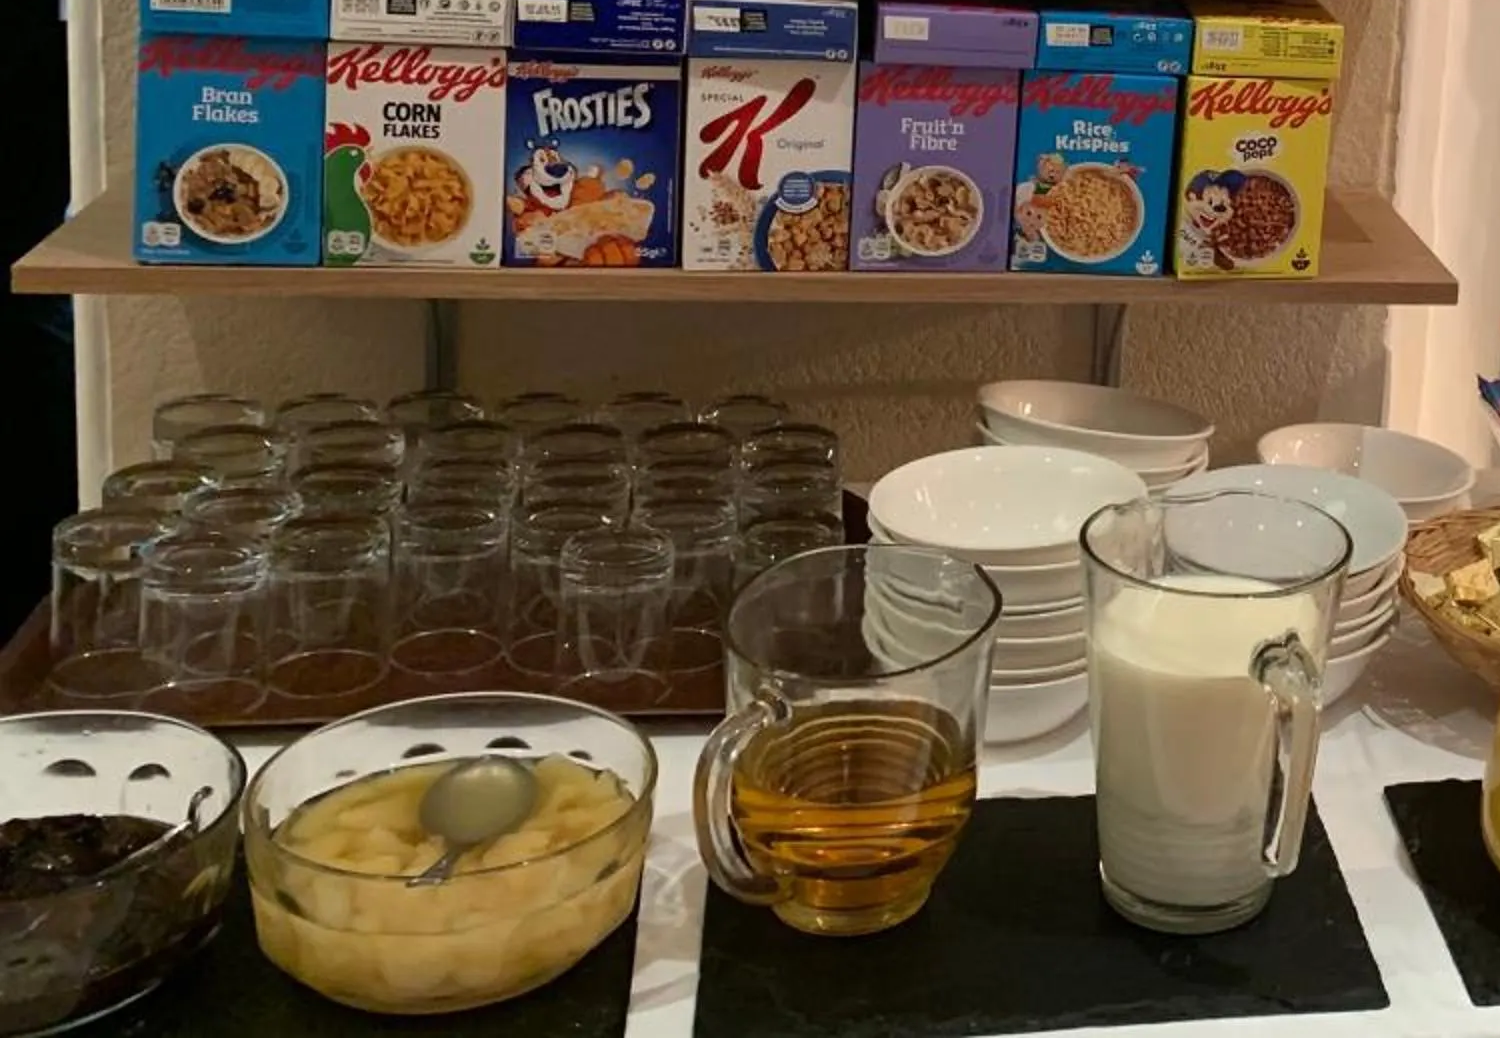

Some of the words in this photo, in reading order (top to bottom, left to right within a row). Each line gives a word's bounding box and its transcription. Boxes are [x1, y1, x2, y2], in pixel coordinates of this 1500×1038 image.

[327, 41, 507, 102] Kellogg's
[202, 86, 253, 105] Bran
[701, 93, 745, 103] SPECIAL
[859, 65, 1018, 116] Kellogg's
[1023, 74, 1176, 125] Kellogg's
[192, 105, 259, 123] Flakes
[382, 102, 442, 123] CORN
[533, 82, 652, 138] FROSTIES
[1190, 79, 1333, 129] Kellogg's
[382, 123, 441, 139] FLAKES
[699, 77, 816, 190] K
[1073, 119, 1114, 138] Rice
[910, 134, 958, 151] Fibre
[1055, 135, 1130, 153] Krispies
